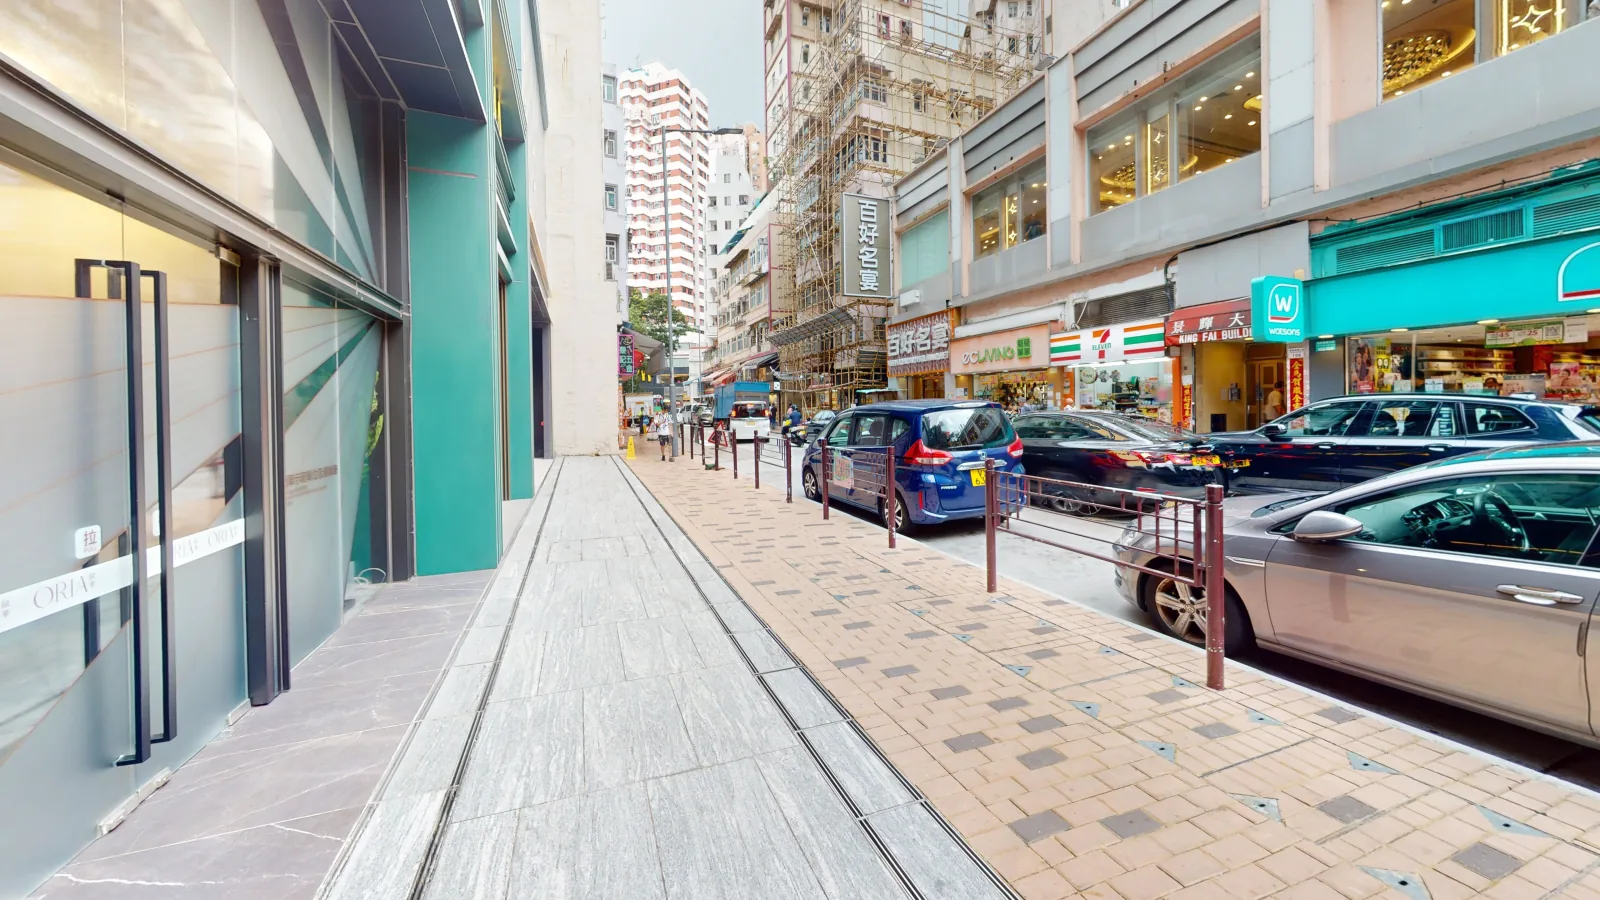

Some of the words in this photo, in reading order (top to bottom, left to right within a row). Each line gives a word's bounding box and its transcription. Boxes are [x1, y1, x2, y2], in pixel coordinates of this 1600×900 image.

[858, 199, 879, 291] 百好名宴
[1275, 293, 1292, 312] W
[888, 323, 949, 357] 百好名宴
[1179, 333, 1198, 344] KING
[1202, 331, 1217, 342] FAI
[1269, 327, 1301, 337] watsons
[83, 529, 97, 547] 拉
[33, 575, 88, 609] ORIA
